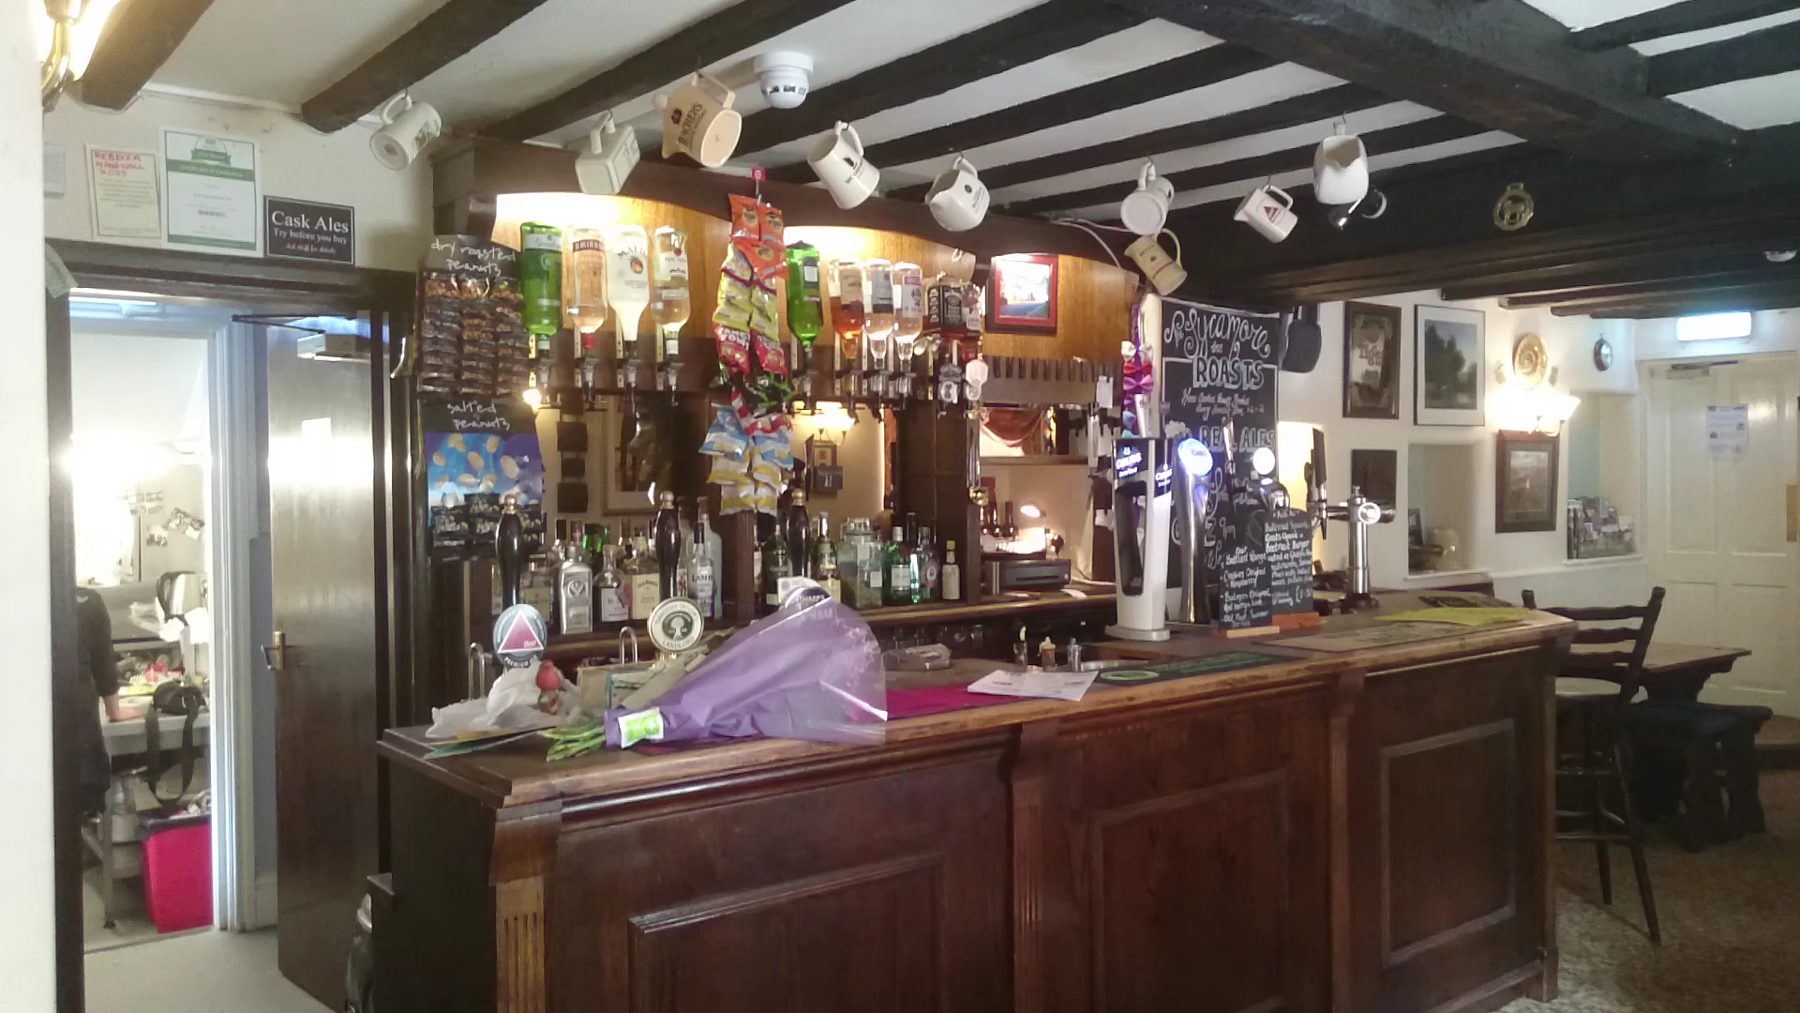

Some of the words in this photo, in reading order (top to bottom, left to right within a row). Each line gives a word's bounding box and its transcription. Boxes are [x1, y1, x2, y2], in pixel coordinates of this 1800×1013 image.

[272, 210, 310, 229] Cask
[315, 216, 349, 233] Ales
[274, 228, 288, 238] Try
[290, 229, 315, 240] before
[317, 234, 331, 242] you
[333, 235, 347, 244] buy
[431, 239, 456, 257] dry
[460, 246, 516, 262] roasted
[1184, 308, 1271, 359] Sycamore
[1192, 356, 1265, 390] ROASTS
[447, 400, 497, 415] salted
[1239, 426, 1275, 453] ALES
[1226, 554, 1248, 565] Bottled
